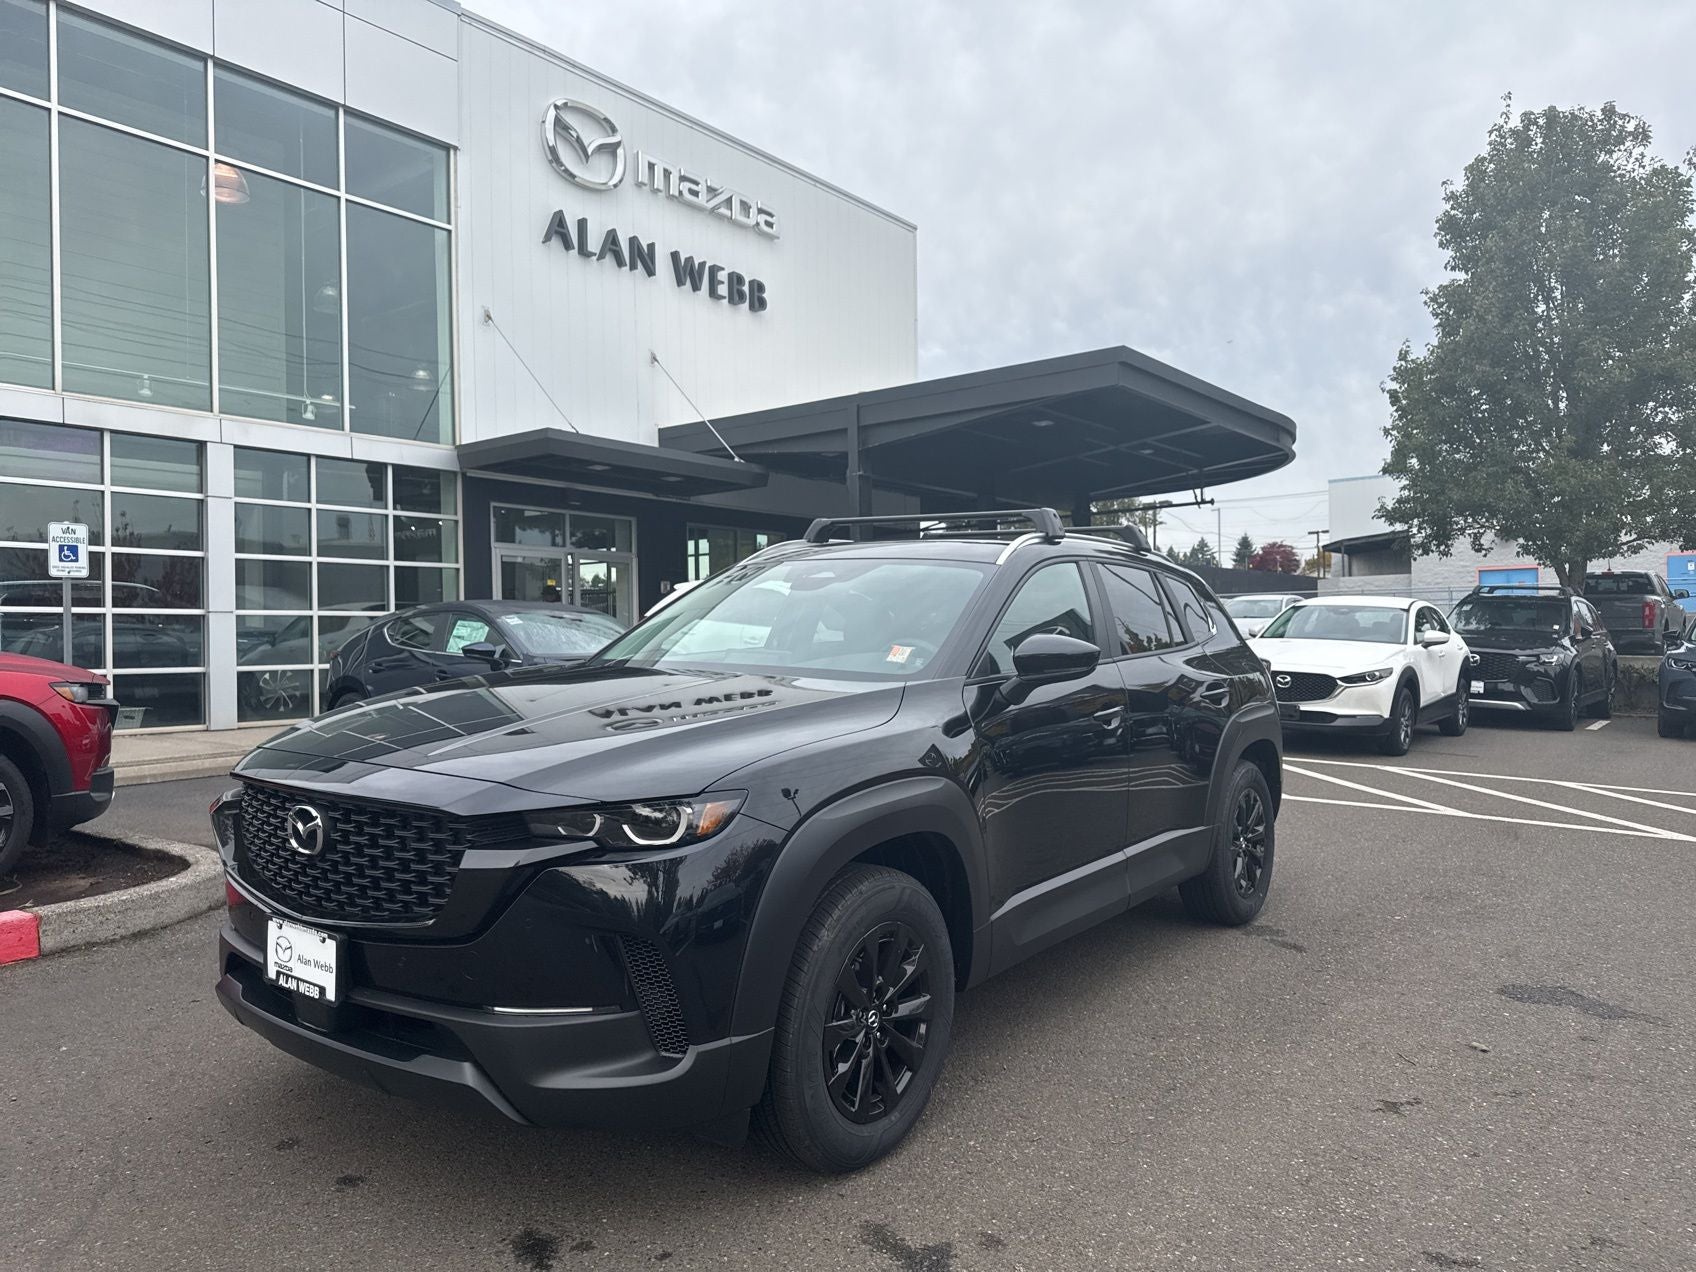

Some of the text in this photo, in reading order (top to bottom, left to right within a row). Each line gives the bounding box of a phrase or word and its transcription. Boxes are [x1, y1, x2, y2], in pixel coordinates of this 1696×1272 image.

[541, 208, 768, 312] ALAN WEBB
[51, 535, 86, 544] ACCESSIBLE
[61, 527, 77, 535] VAN
[297, 953, 334, 974] Alan Webb
[278, 973, 320, 999] ALAN WEBB
